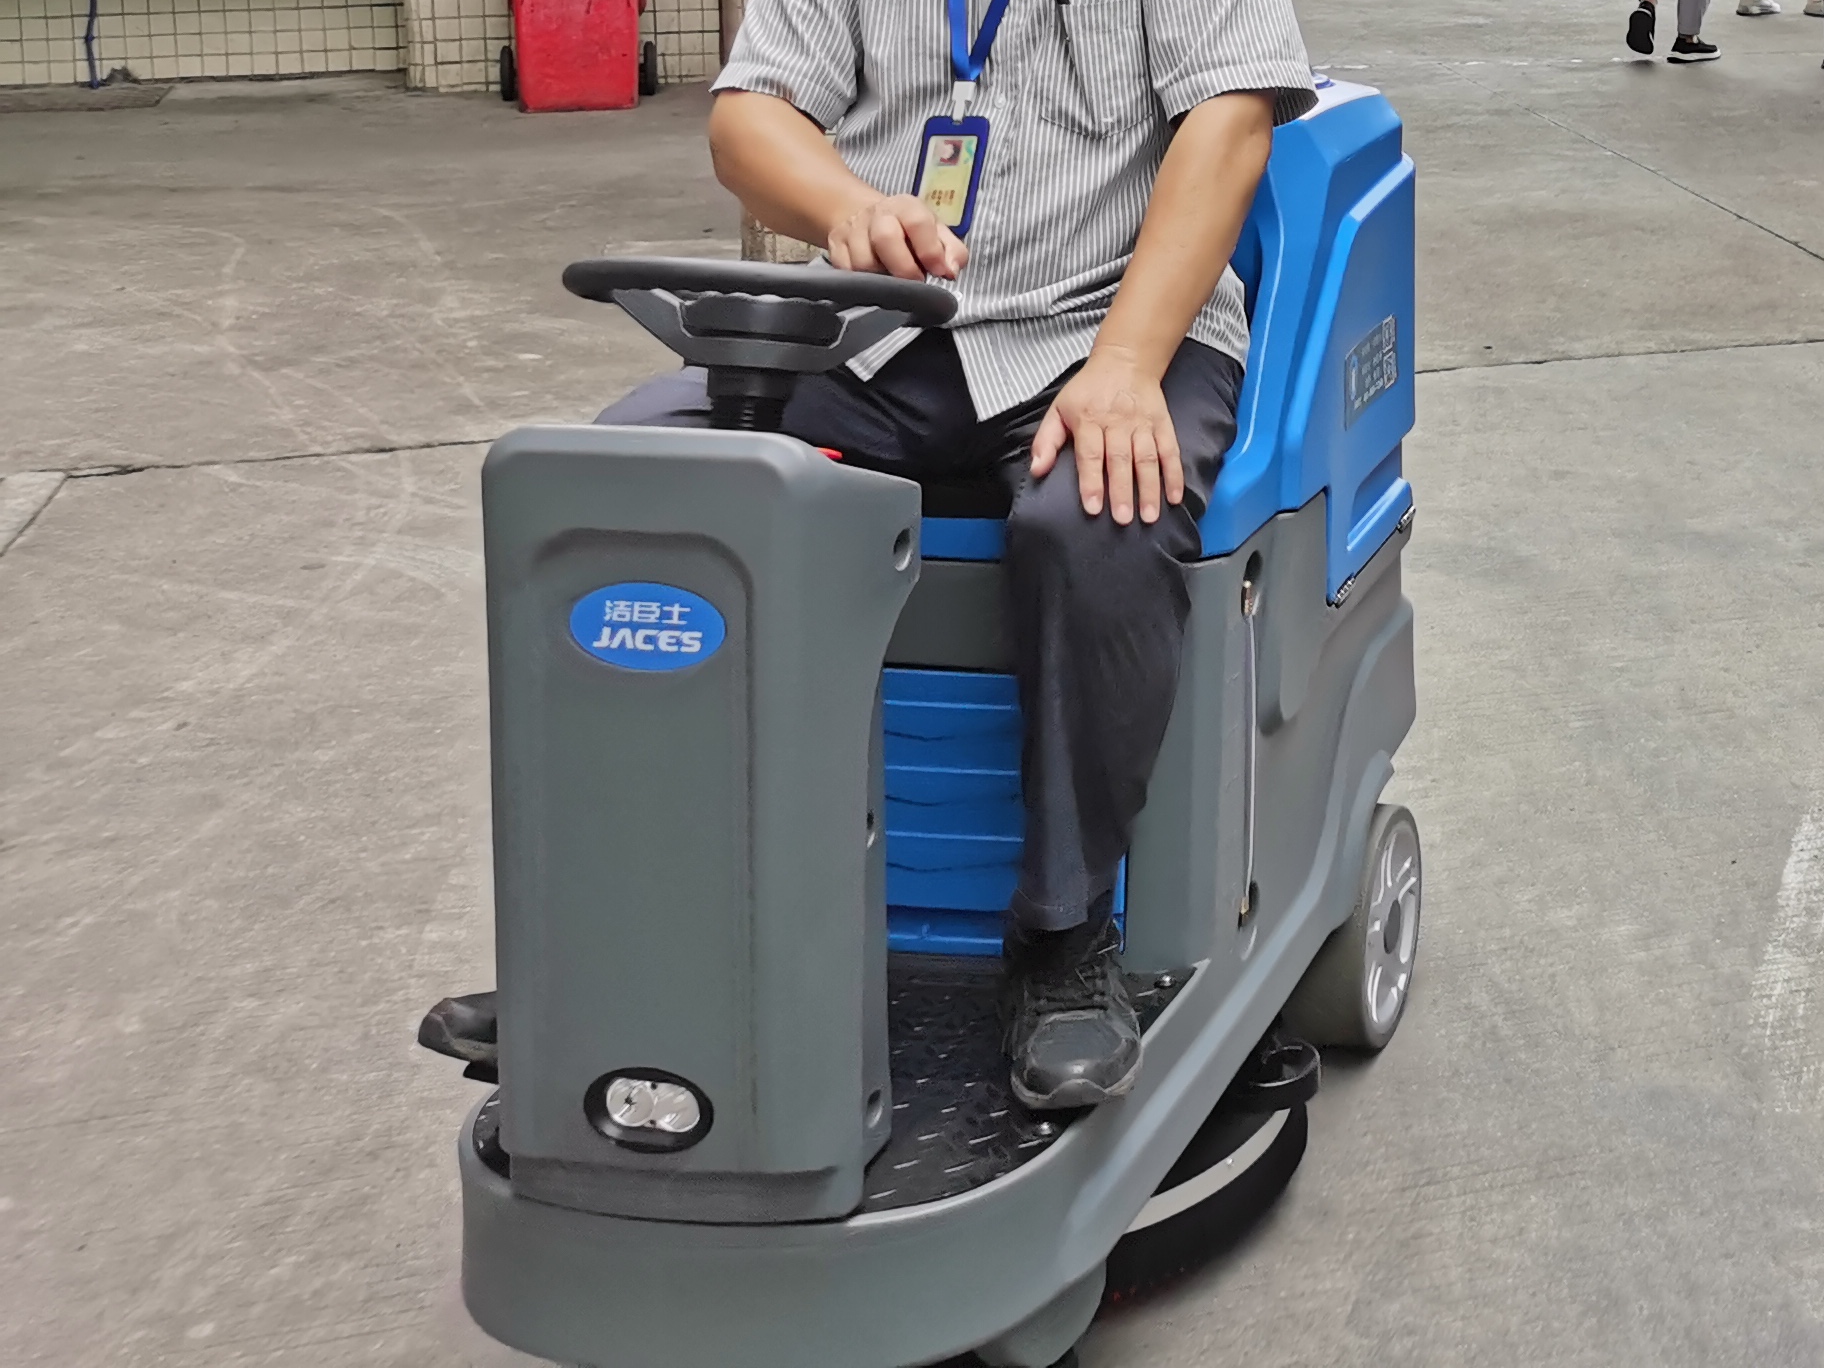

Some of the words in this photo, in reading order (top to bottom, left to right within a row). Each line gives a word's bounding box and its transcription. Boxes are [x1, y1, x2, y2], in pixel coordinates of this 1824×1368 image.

[604, 599, 691, 625] 洁臣士
[592, 626, 703, 652] JACES
